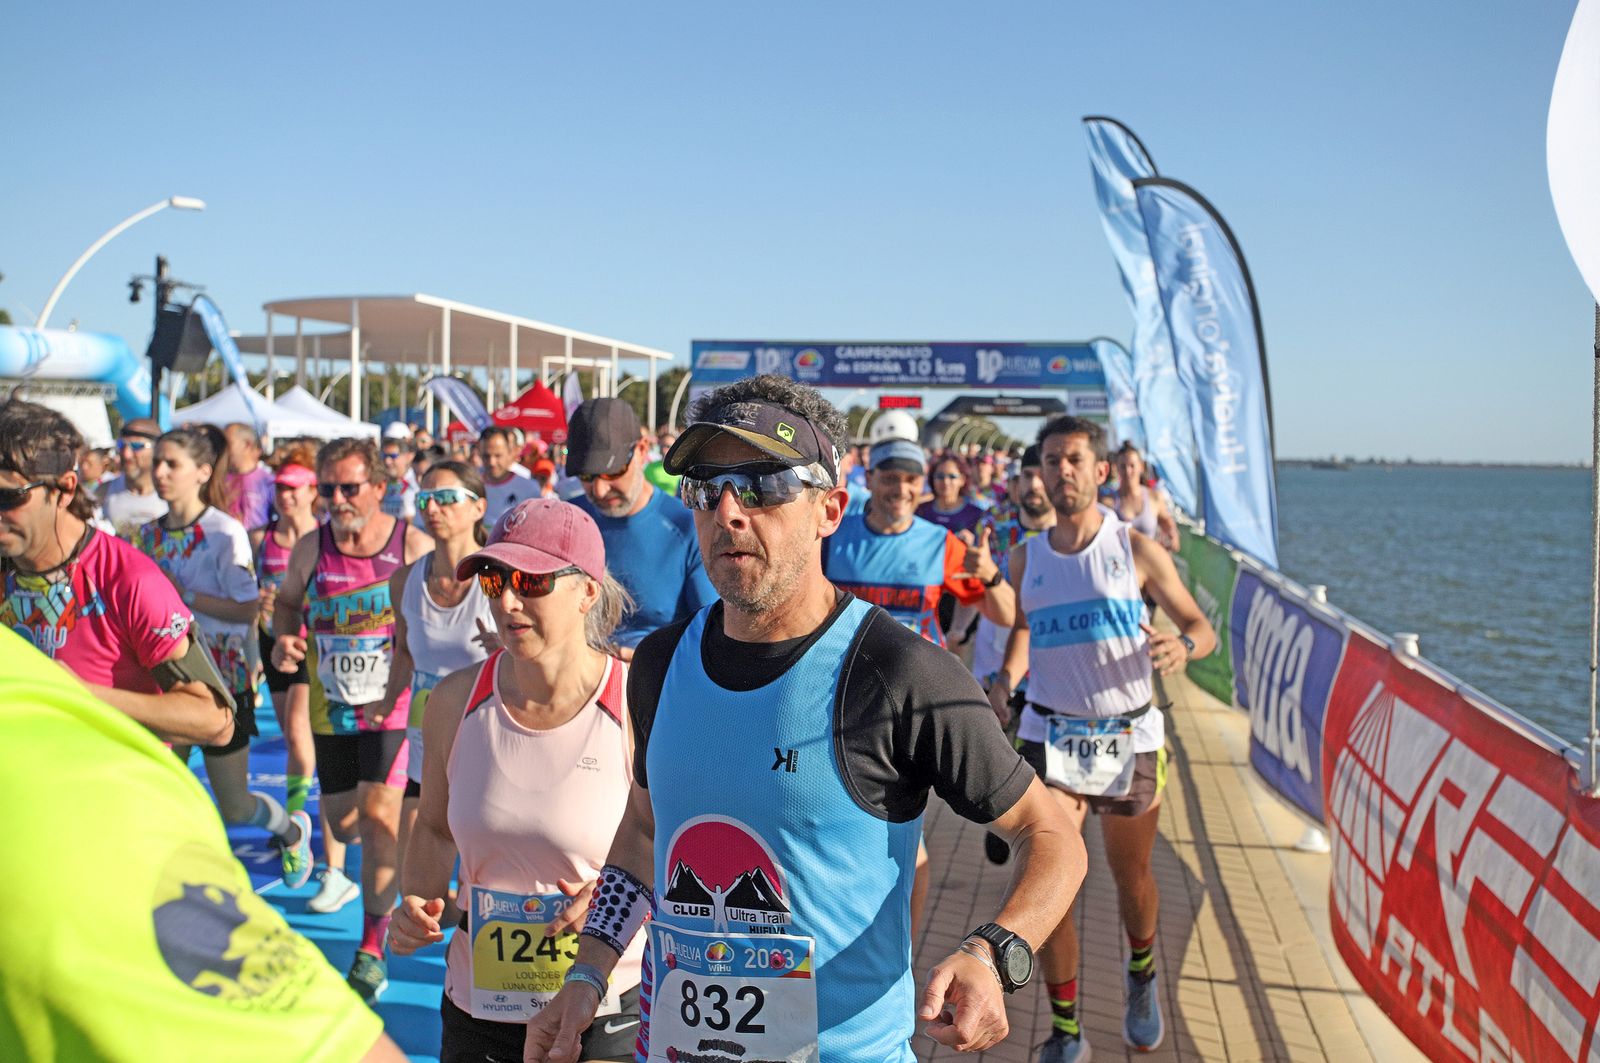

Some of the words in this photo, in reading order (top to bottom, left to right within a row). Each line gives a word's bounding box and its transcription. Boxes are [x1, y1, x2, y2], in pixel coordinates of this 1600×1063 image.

[908, 359, 932, 376] 10
[935, 358, 967, 376] km
[330, 655, 379, 674] 1097
[1064, 738, 1120, 759] 1084
[673, 904, 711, 917] CLUB
[730, 911, 757, 923] Ultra
[760, 911, 785, 924] Trail
[675, 943, 702, 961] HUELVA
[744, 948, 796, 970] 203
[515, 970, 561, 980] LOURDES
[708, 964, 732, 973] WiHu
[502, 982, 526, 991] LUNA
[482, 1003, 523, 1013] HYUNDAI
[530, 998, 553, 1010] Syr
[680, 979, 766, 1034] 832
